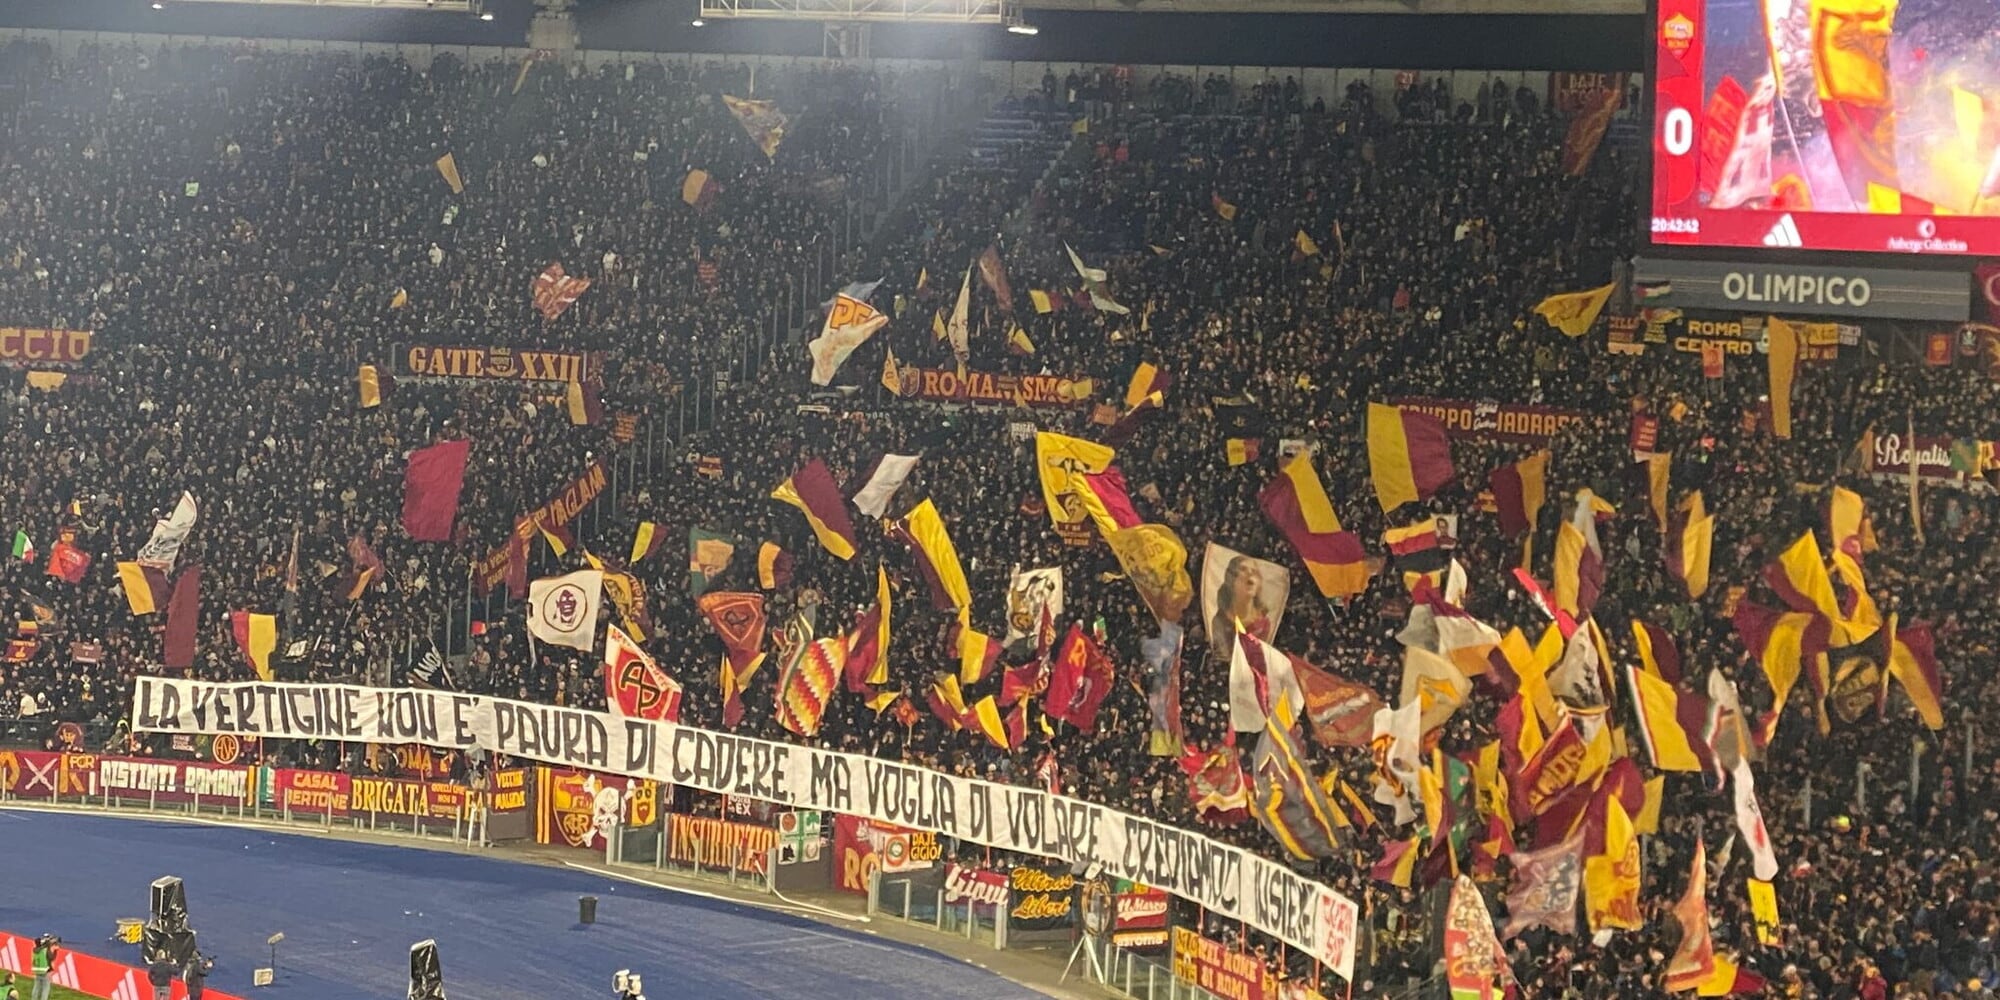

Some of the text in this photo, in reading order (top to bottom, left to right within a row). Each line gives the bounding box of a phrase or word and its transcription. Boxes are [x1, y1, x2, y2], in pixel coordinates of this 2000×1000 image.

[1664, 108, 1693, 155] 0
[1652, 219, 1699, 233] 20:42:42
[1925, 239, 1967, 251] Collection
[1723, 272, 1870, 306] OLIMPICO
[1688, 321, 1741, 337] ROMA
[409, 347, 580, 381] GATE XXII
[100, 761, 176, 792] DISTINTI
[293, 773, 338, 790] CASAL
[139, 681, 180, 728] LA
[192, 685, 361, 736] VERTIGINE
[377, 692, 438, 741] NON
[493, 702, 607, 767] PAURA
[626, 720, 656, 774] DI
[672, 728, 796, 804] CADERE,
[810, 752, 850, 810] MA
[865, 760, 957, 834] VOGLIA
[970, 783, 992, 842] DI
[1123, 817, 1242, 915] CREDIAMOCI
[351, 780, 430, 817] BRIGATA
[912, 832, 936, 846] DAJE
[1012, 867, 1073, 892] Ultras
[1011, 894, 1071, 919] Liberi
[1223, 950, 1258, 983] NOME
[1217, 970, 1249, 1000] ROMA
